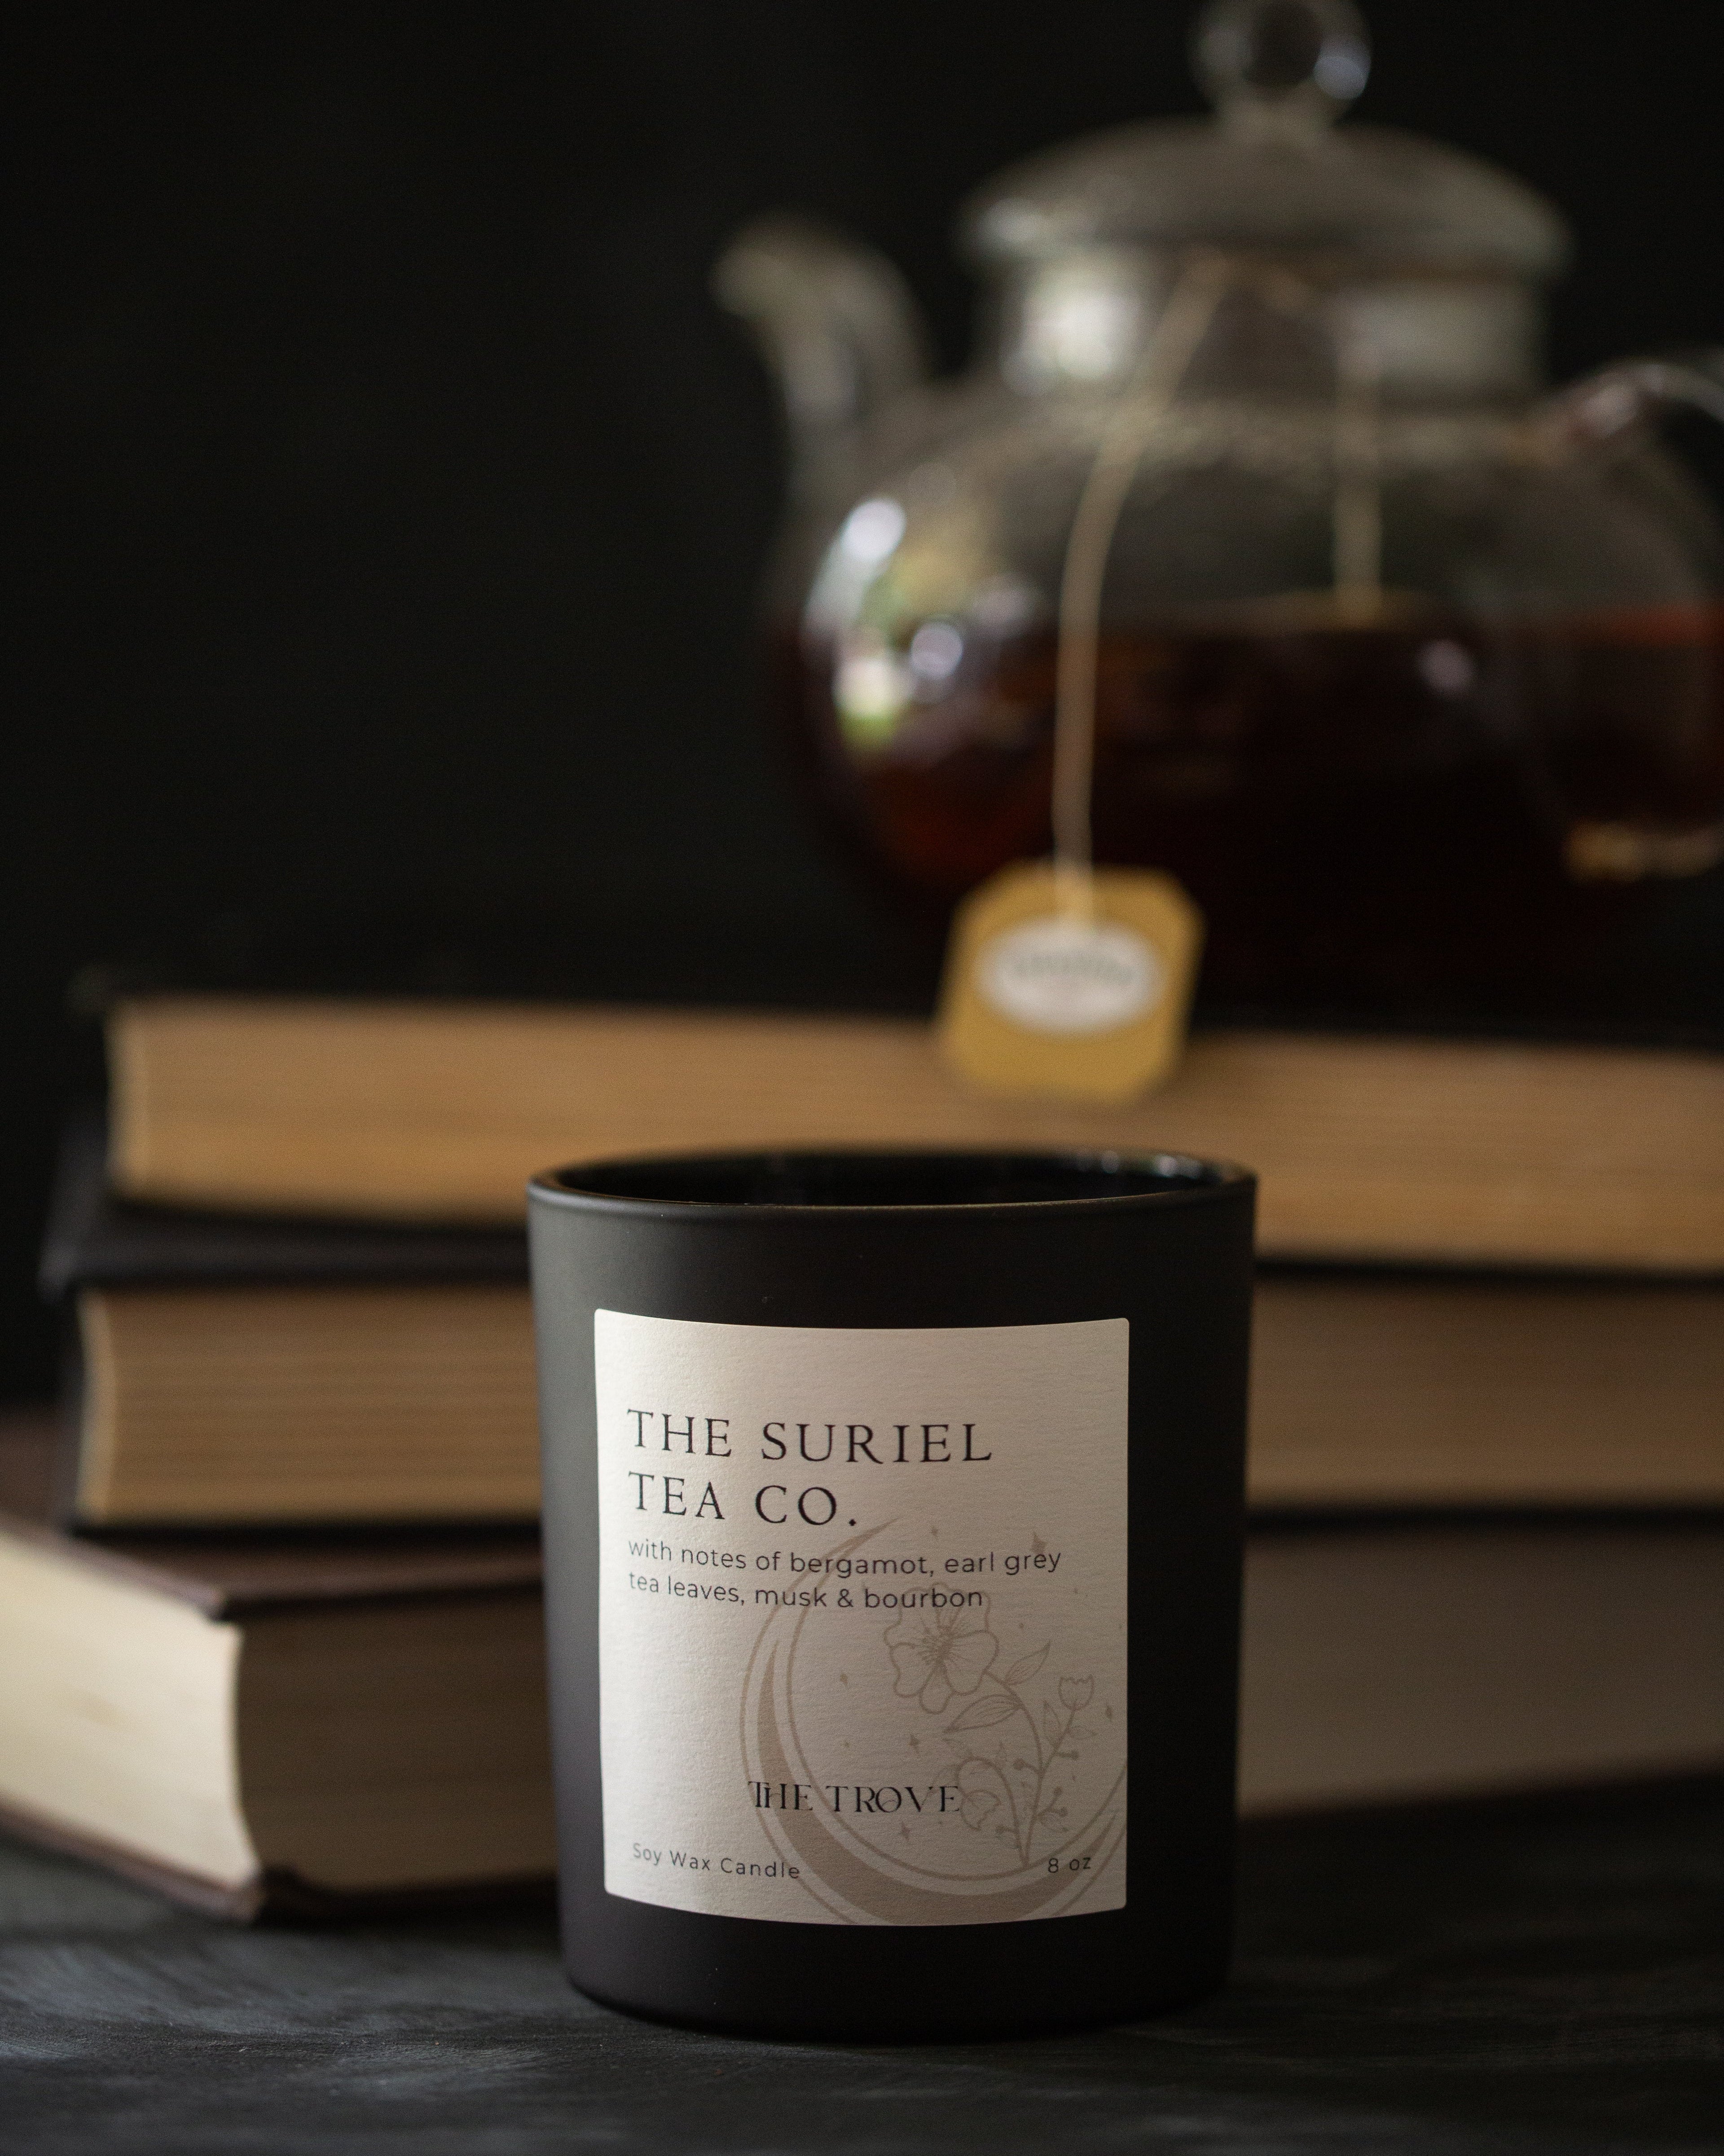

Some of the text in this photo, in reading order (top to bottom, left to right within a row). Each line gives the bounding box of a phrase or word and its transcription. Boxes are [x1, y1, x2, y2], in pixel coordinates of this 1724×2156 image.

[627, 1409, 992, 1464] THE SURIEL
[629, 1472, 857, 1526] TEA CO.
[629, 1539, 1060, 1578] with notes of bergamot, earl grey
[629, 1571, 982, 1609] tea leaves, musk & bourbon
[748, 1781, 961, 1813] THE TROVE
[633, 1843, 800, 1879] Soy Wax Candle
[1048, 1856, 1091, 1873] 8 oz
